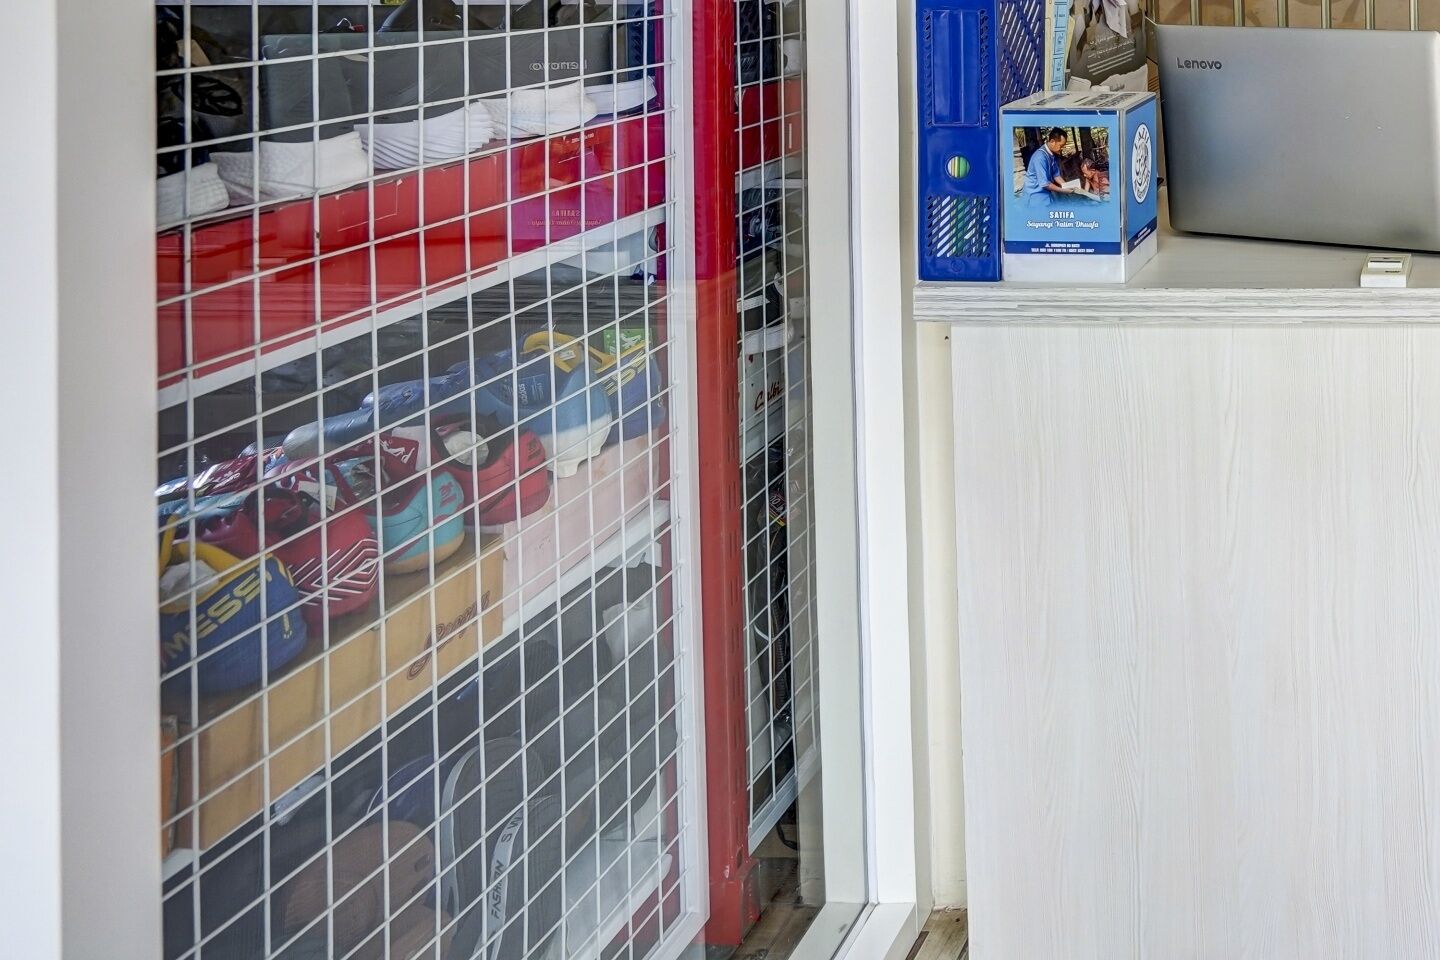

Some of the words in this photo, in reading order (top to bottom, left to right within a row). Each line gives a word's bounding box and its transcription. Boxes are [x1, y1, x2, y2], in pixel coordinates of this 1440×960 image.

[1176, 57, 1222, 70] Lenovo
[1049, 211, 1075, 219] SATIFA
[1026, 220, 1053, 229] Sayangi
